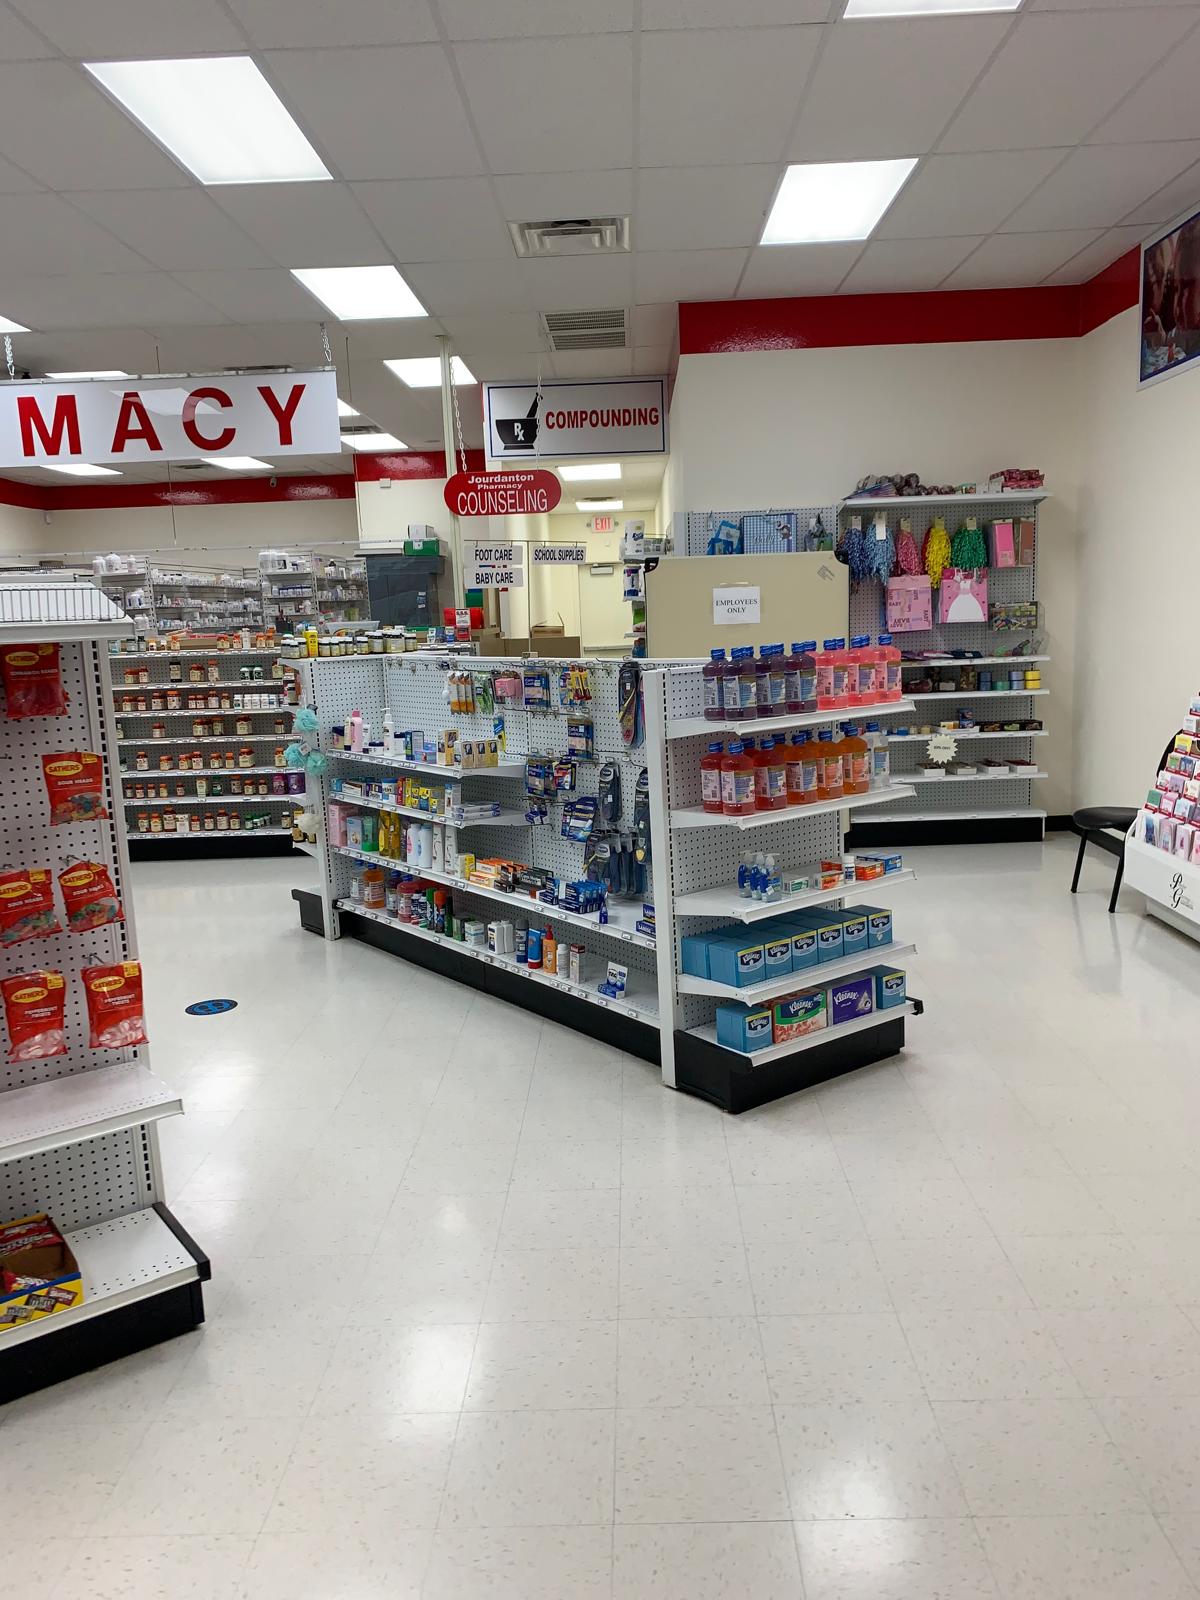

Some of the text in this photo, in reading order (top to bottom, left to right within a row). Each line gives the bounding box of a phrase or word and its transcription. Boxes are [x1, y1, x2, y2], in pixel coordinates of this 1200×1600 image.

[545, 407, 660, 430] COMPOUNDING
[468, 473, 535, 485] Jourdanton
[477, 482, 523, 491] Pharmacy
[457, 488, 548, 516] COUNSELING
[594, 516, 613, 531] EXIT
[475, 549, 513, 561] FOOT CARE
[534, 549, 584, 561] SCHOOL SUPPLIES
[475, 571, 514, 585] BABY CARE
[715, 598, 758, 607] EMPLOYEES
[727, 606, 746, 614] ONLY
[49, 763, 80, 773] SATHERS
[834, 991, 859, 1006] Kleenex
[789, 999, 814, 1014] Kleenex
